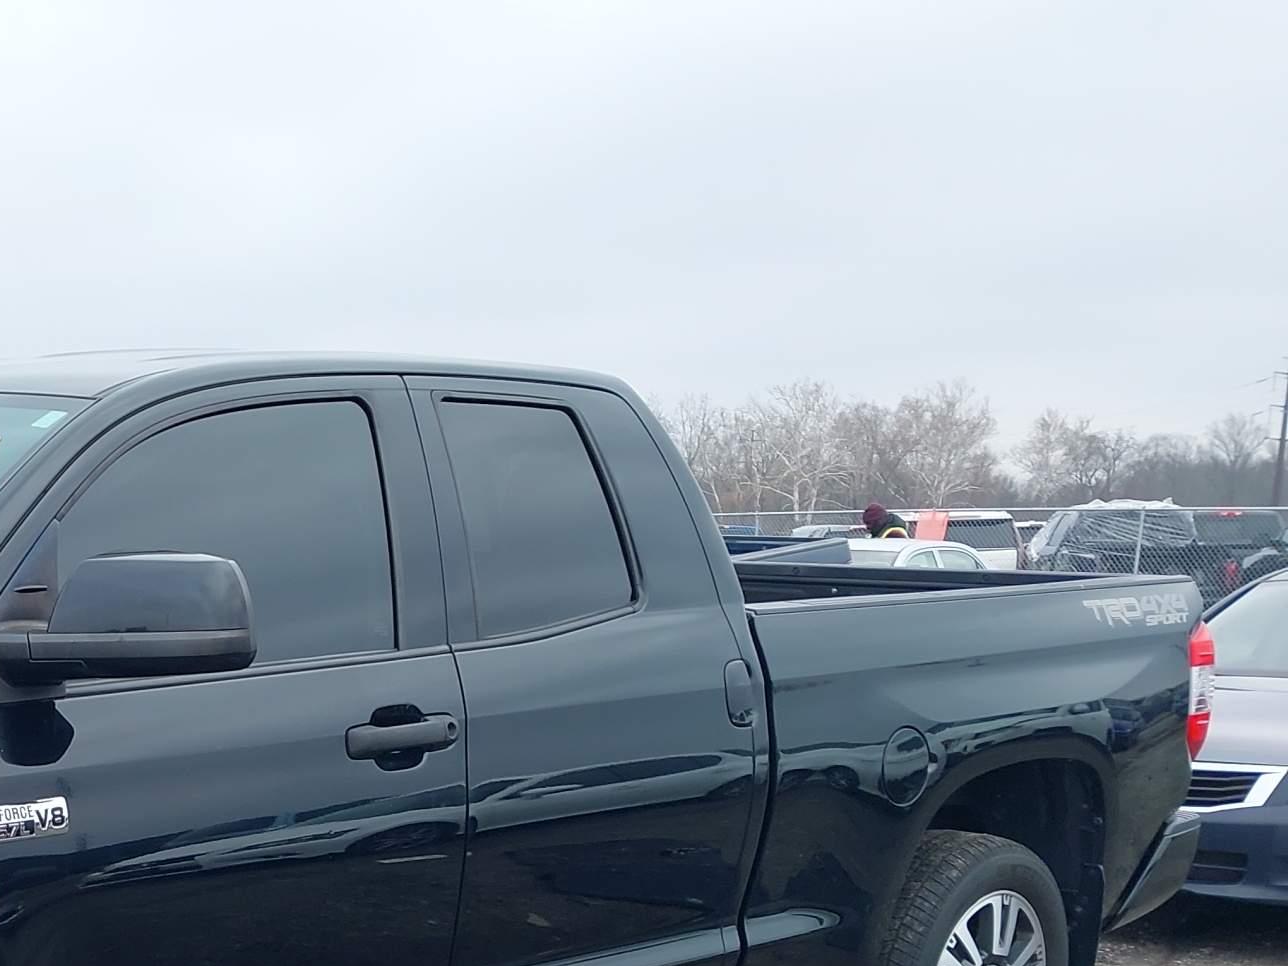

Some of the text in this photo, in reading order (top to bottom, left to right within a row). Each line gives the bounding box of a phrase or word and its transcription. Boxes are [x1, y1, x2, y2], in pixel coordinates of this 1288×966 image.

[1082, 597, 1141, 627] TRD
[1145, 612, 1189, 626] SPORT
[35, 806, 66, 831] V8
